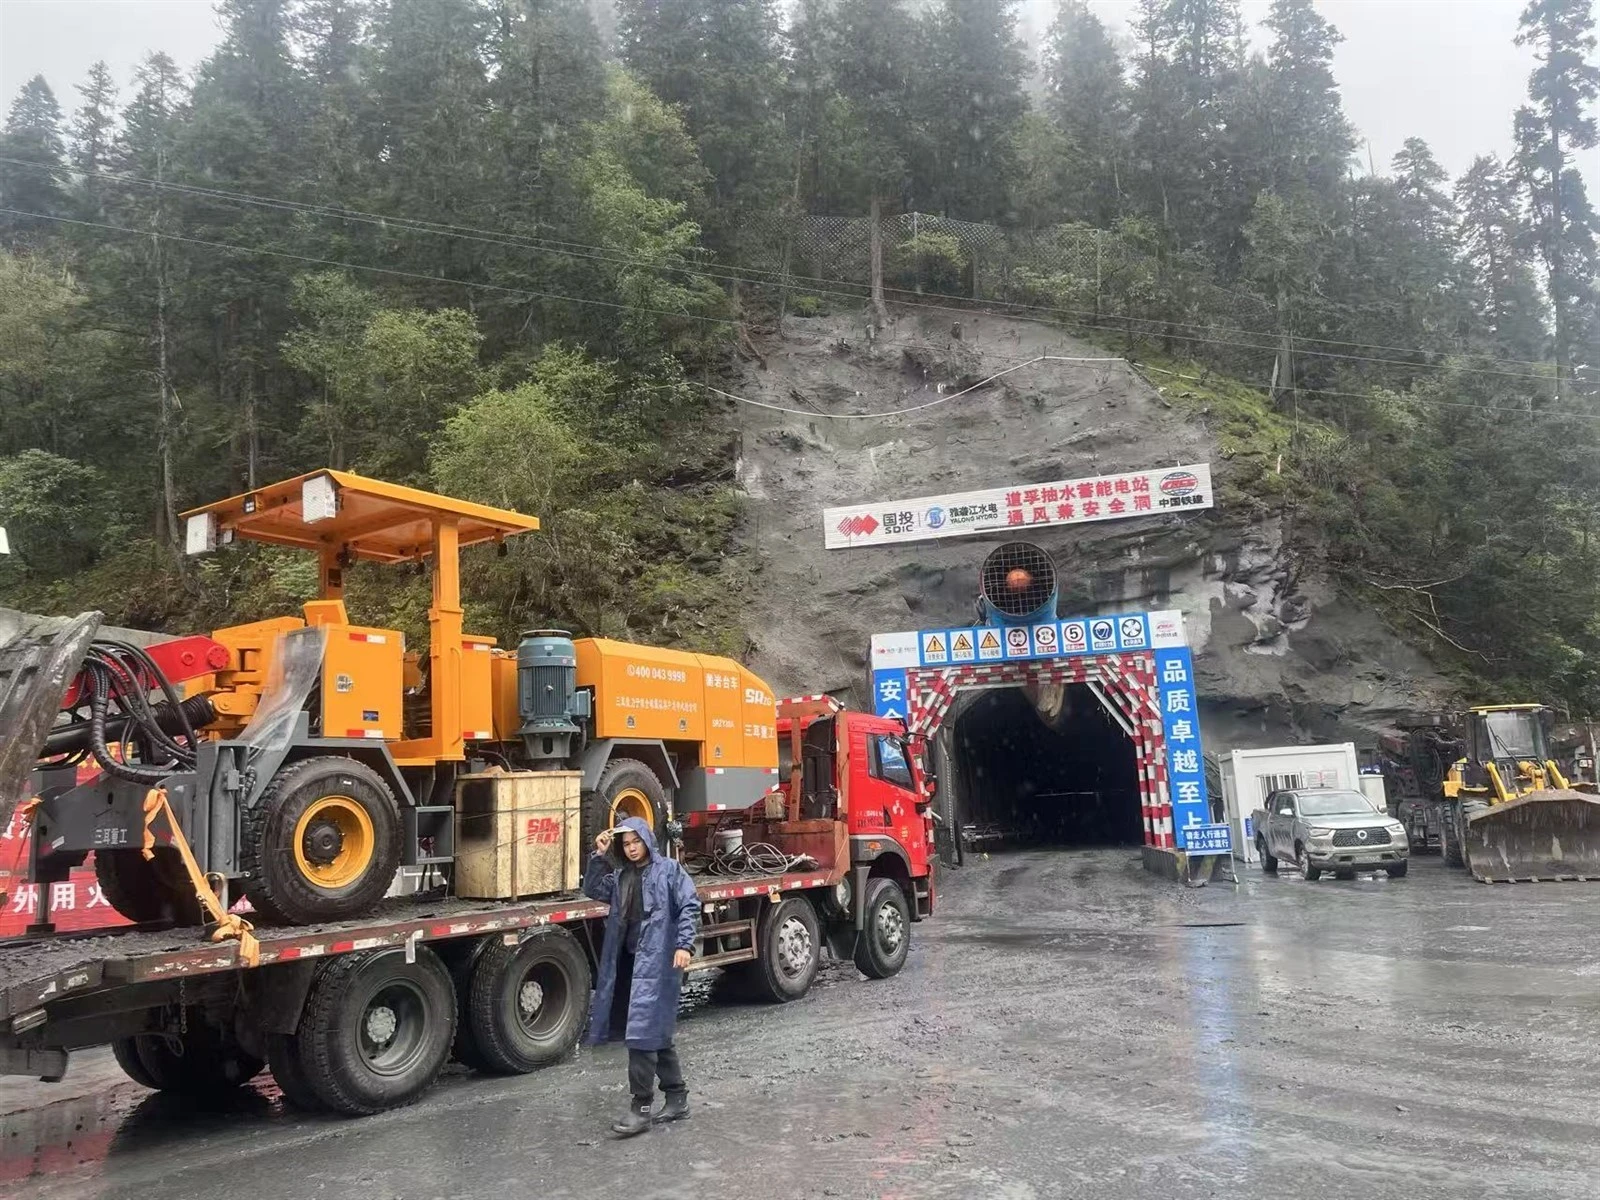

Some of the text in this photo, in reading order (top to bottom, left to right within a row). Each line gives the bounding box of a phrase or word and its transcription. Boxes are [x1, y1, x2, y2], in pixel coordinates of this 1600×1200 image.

[1005, 476, 1149, 507] 道孚抽水蓄能电站
[1159, 495, 1204, 508] 中国铁建
[1007, 495, 1151, 525] 通风兼安全洞
[883, 511, 914, 527] 国投
[950, 513, 998, 524] YALONG HYDRO
[1069, 627, 1079, 639] 5
[635, 666, 650, 678] 400
[652, 668, 666, 680] 043
[745, 724, 775, 739] 三耳重工
[1163, 660, 1204, 830] 品质卓越至上
[94, 828, 128, 844] 三耳重工
